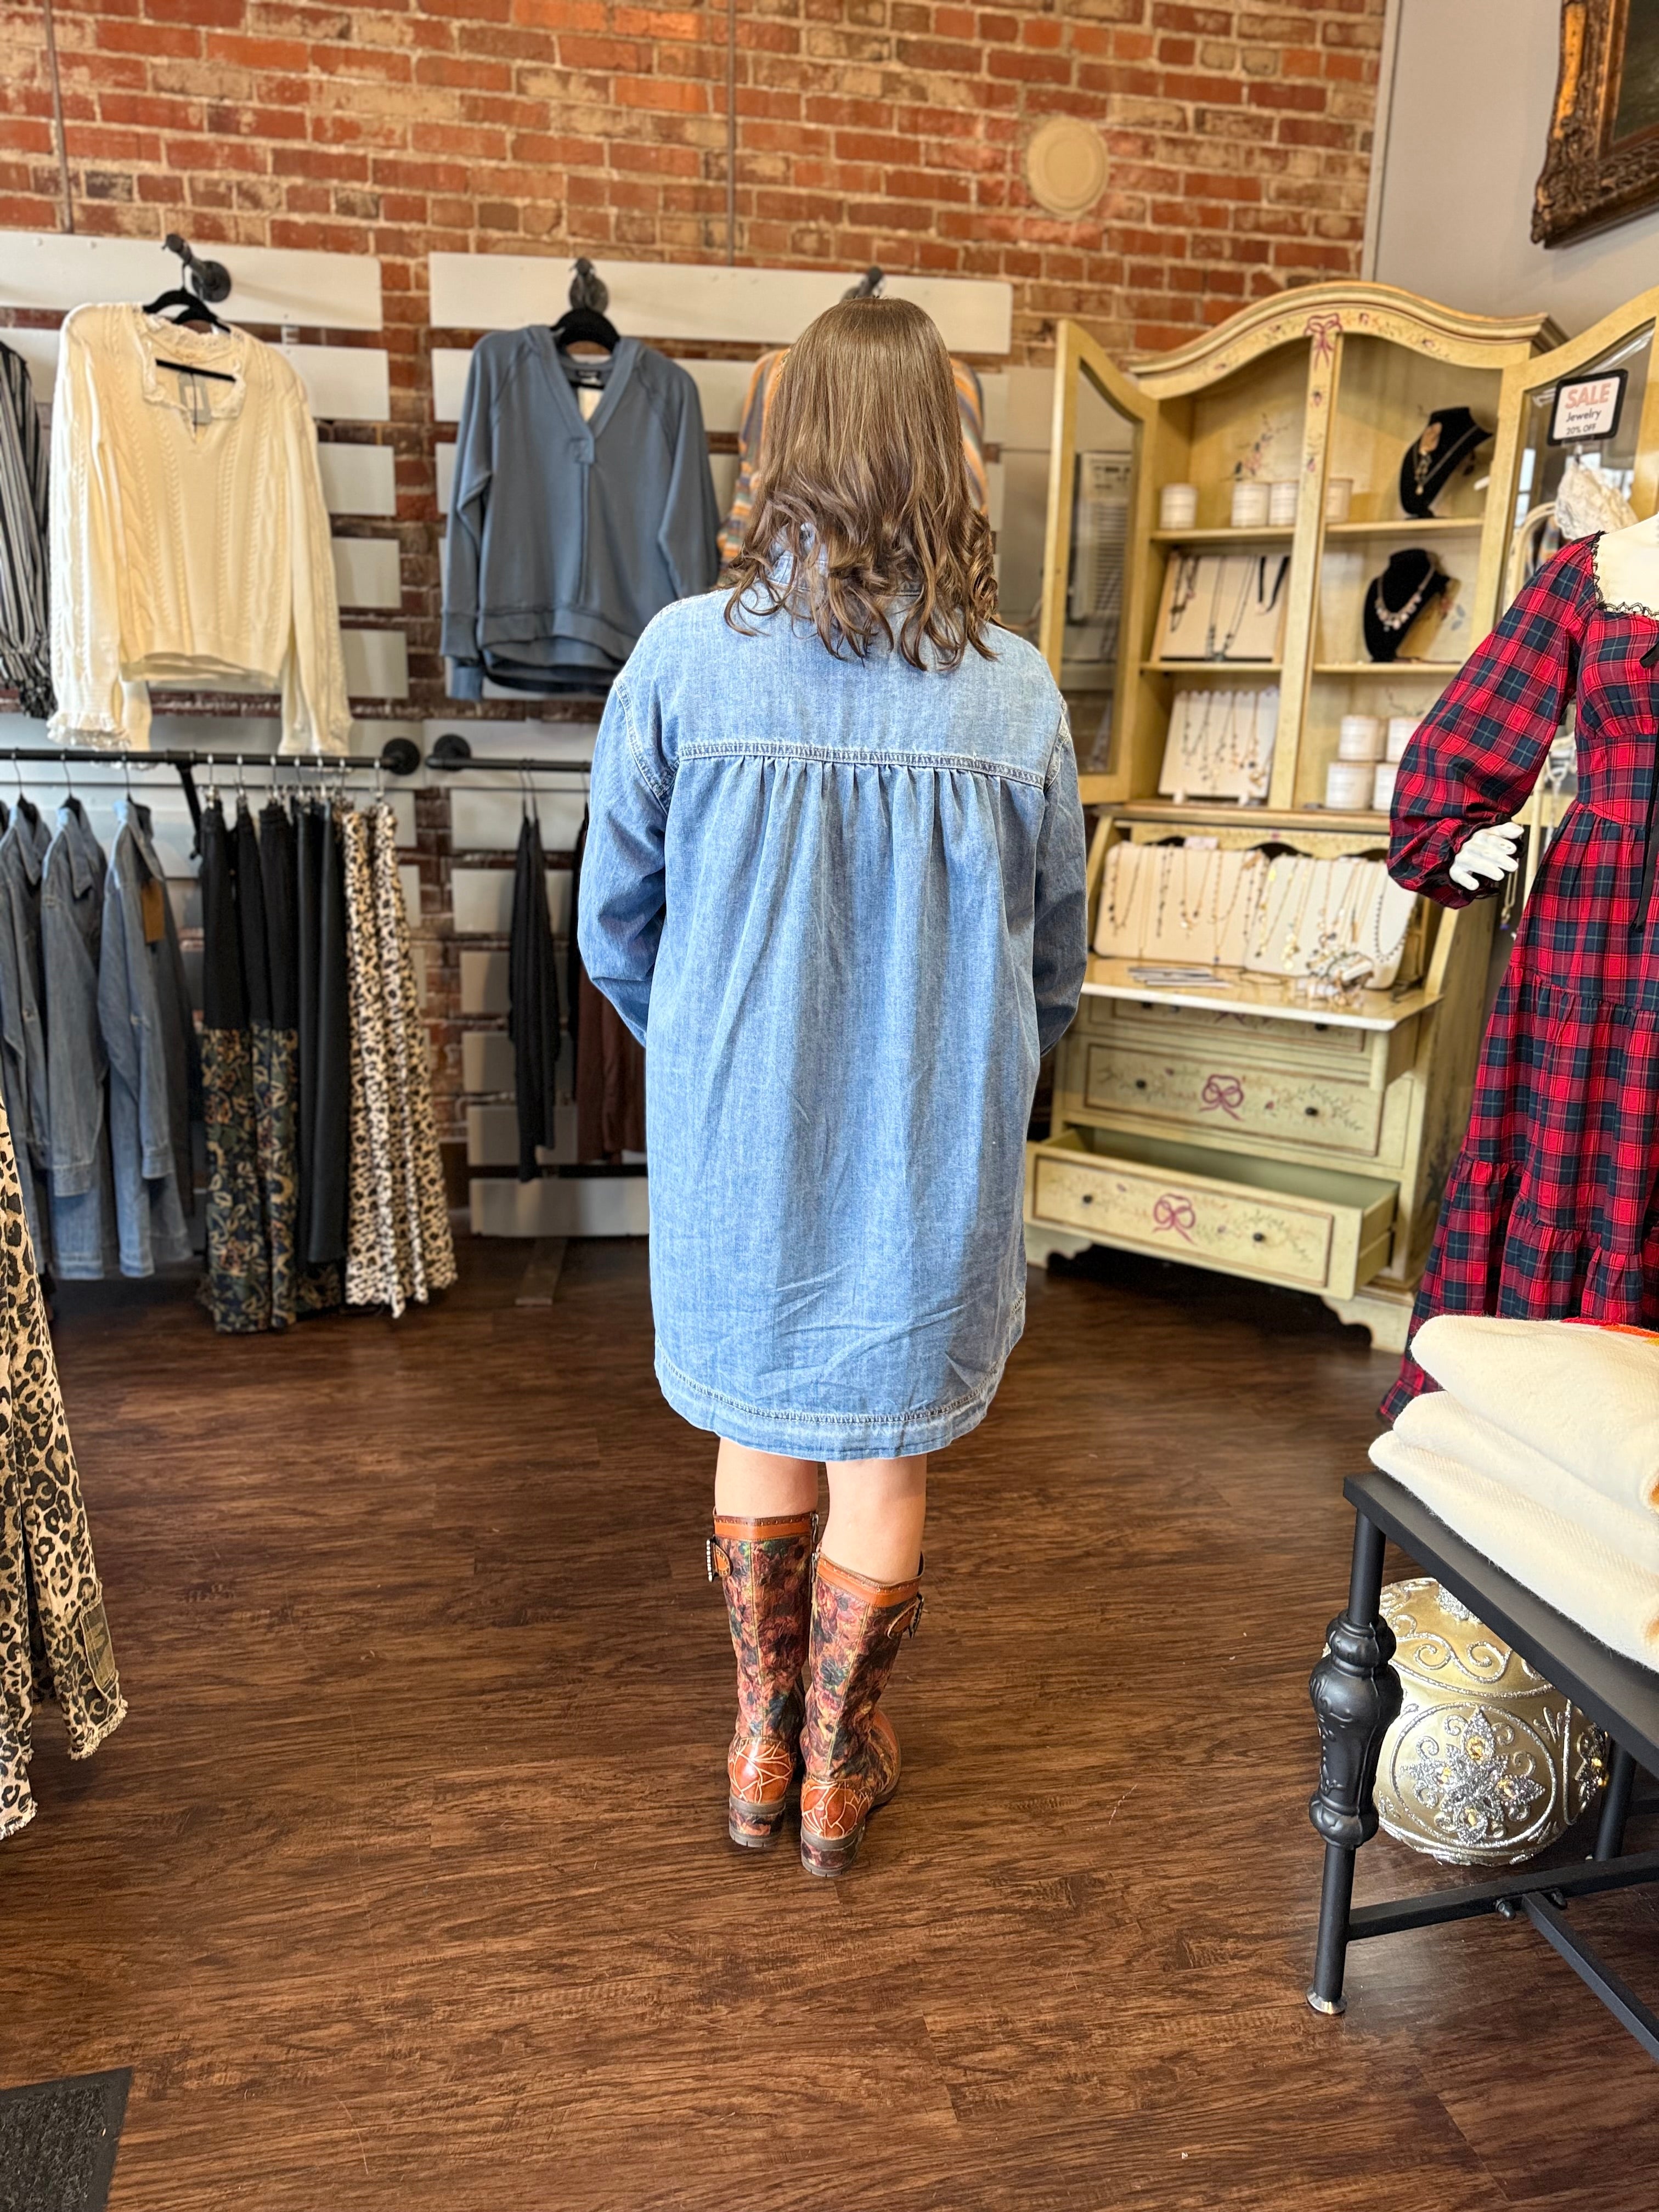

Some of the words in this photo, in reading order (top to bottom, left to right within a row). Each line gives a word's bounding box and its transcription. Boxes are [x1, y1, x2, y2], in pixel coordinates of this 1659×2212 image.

[1565, 383, 1611, 409] SALE
[1566, 408, 1601, 422] Jewelry
[1566, 426, 1581, 435] 20%
[1583, 423, 1596, 432] OFF
